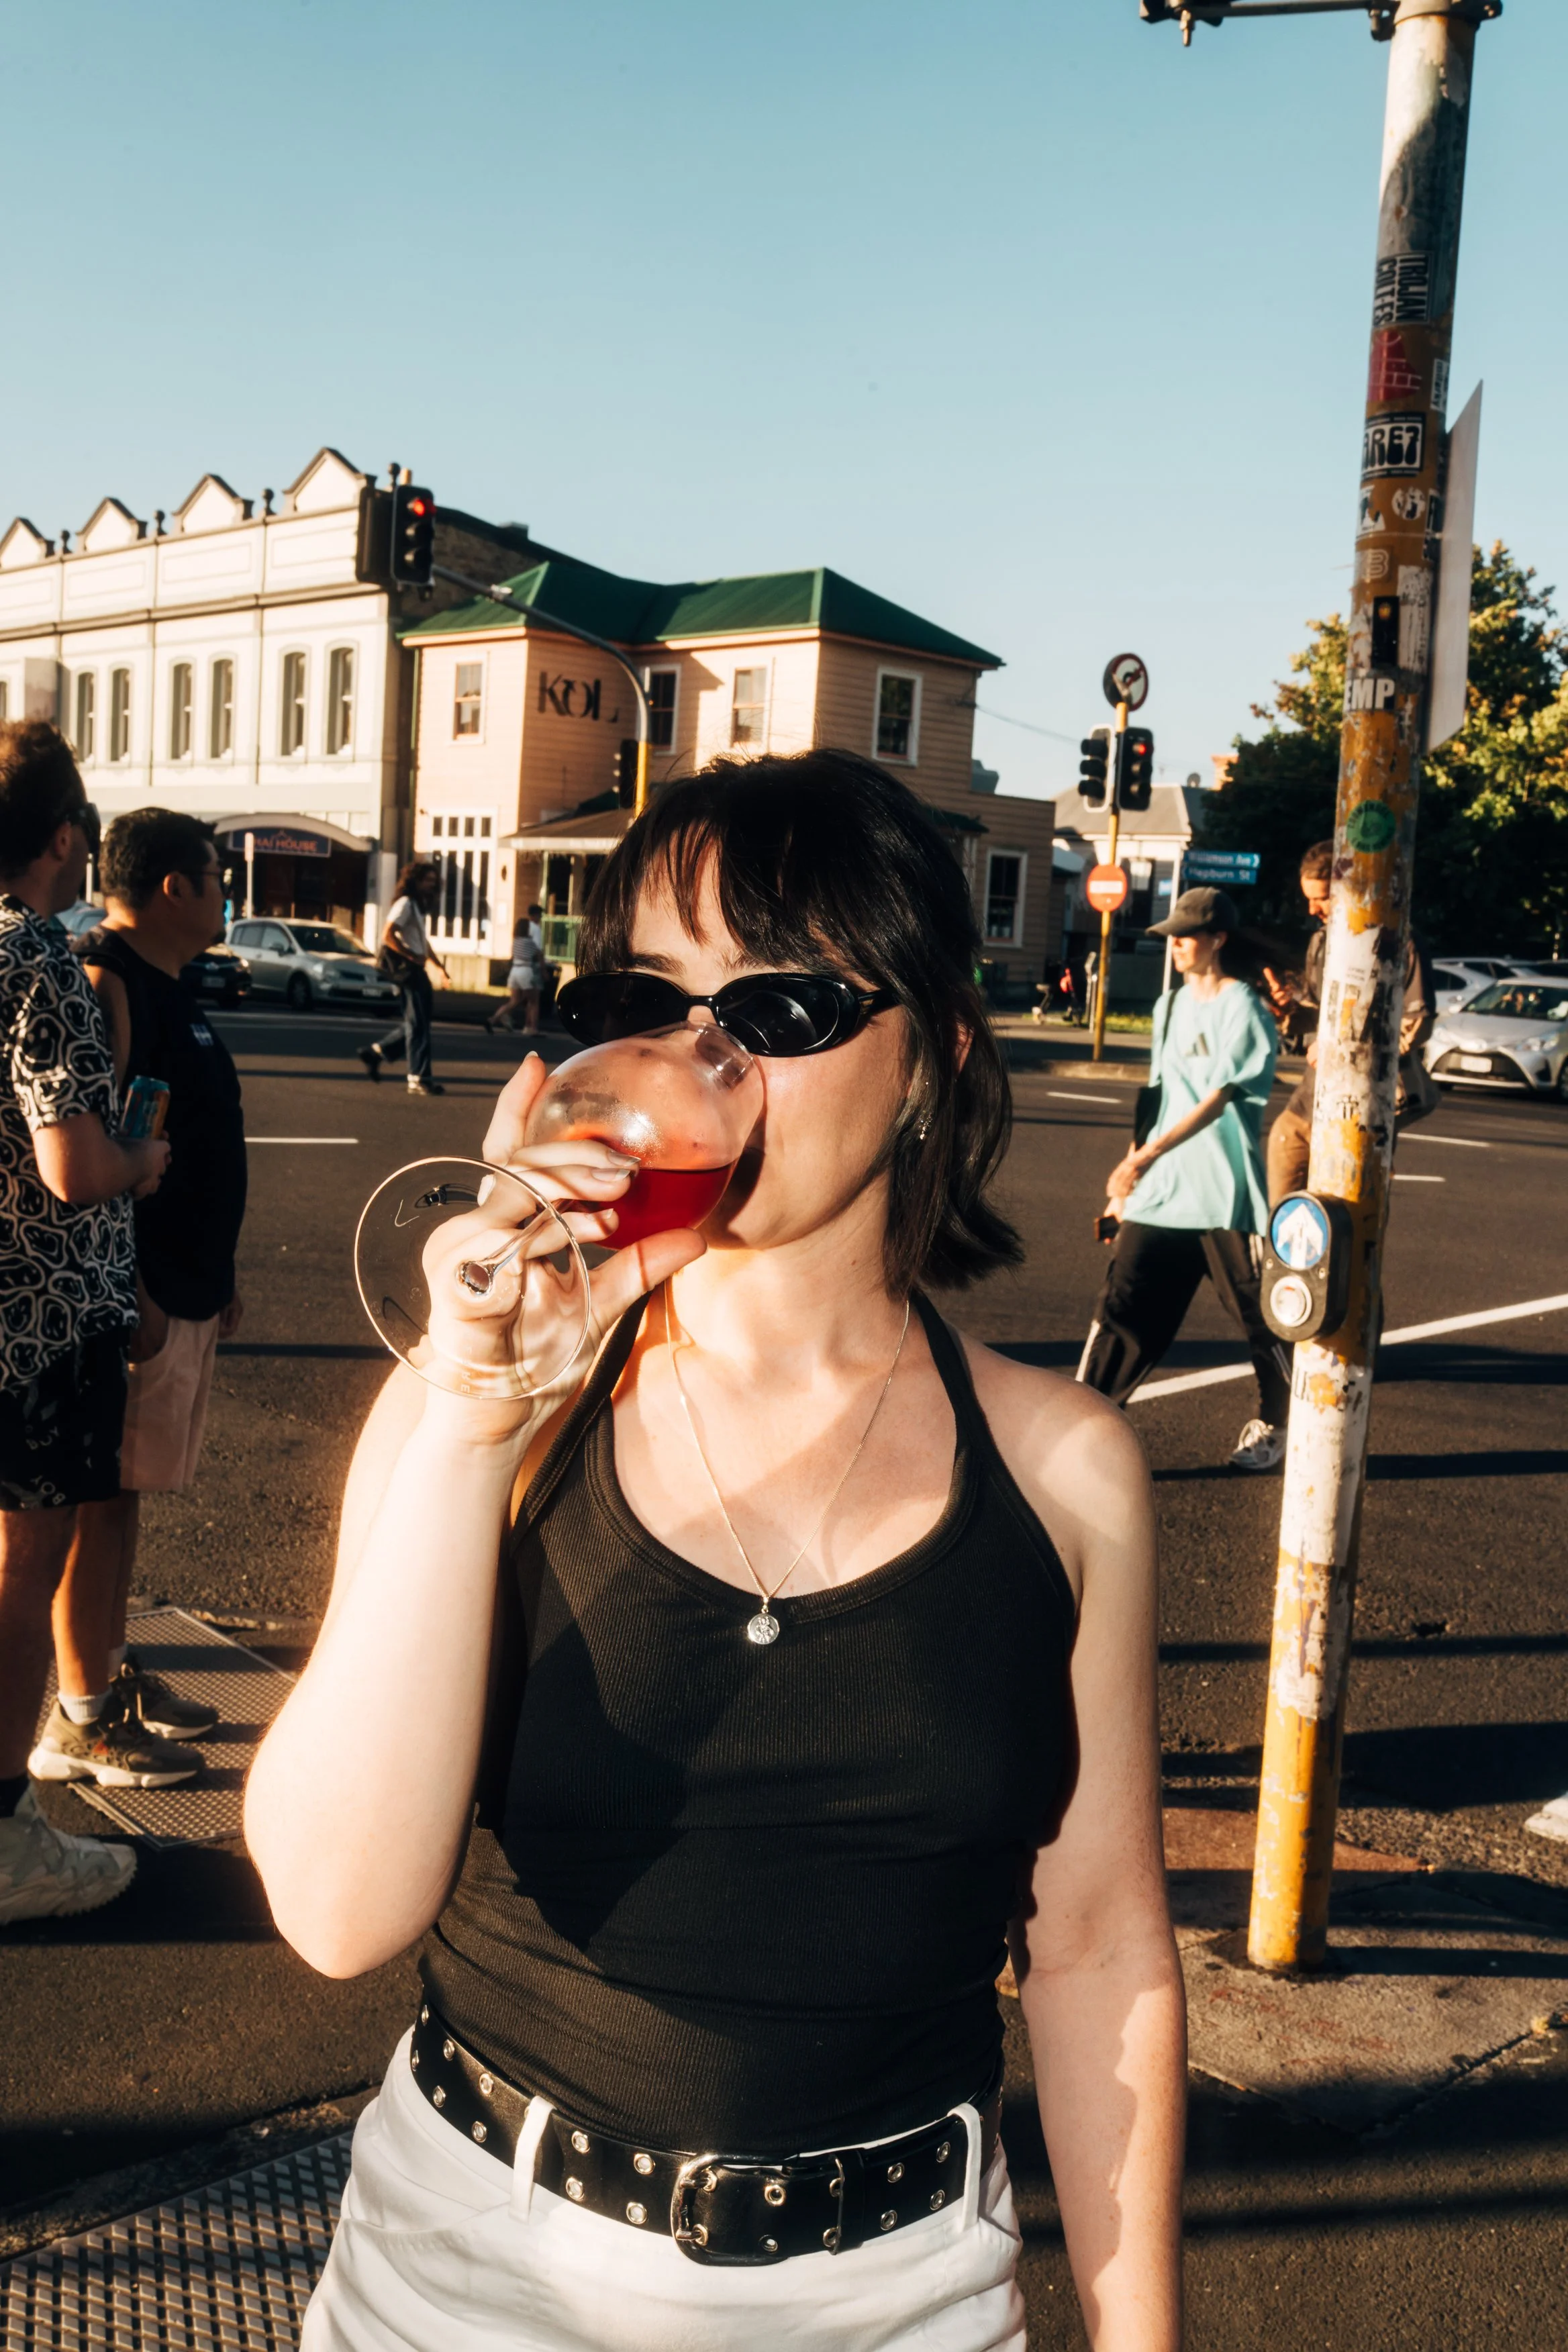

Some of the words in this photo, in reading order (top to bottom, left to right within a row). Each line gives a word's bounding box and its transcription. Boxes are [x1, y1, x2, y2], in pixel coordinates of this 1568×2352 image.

[1398, 256, 1427, 320] TROJAN
[276, 840, 317, 852] HOUSE
[1239, 869, 1251, 881] St
[30, 1475, 66, 1505] BOY
